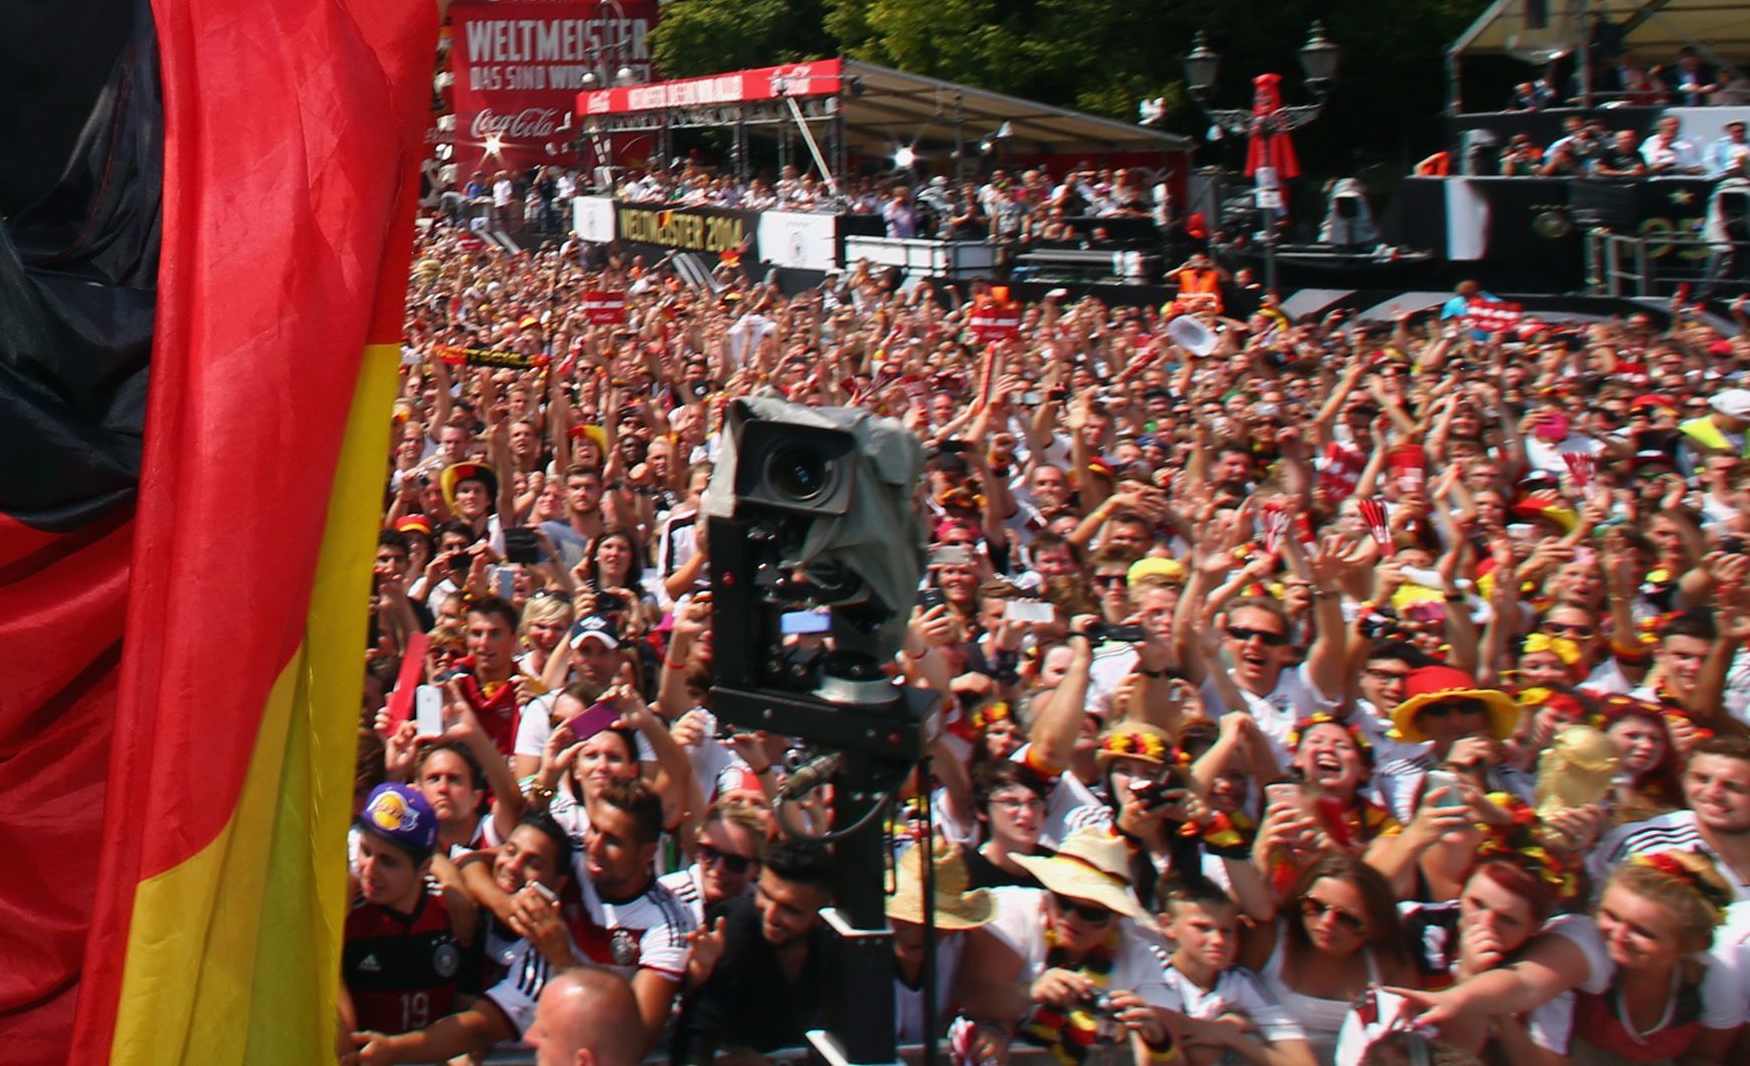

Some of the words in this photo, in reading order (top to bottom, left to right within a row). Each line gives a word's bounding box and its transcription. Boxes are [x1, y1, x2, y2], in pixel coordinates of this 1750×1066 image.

[466, 18, 649, 63] WELTMEISTER
[470, 107, 559, 139] Coca-Cola
[400, 992, 429, 1033] 19
